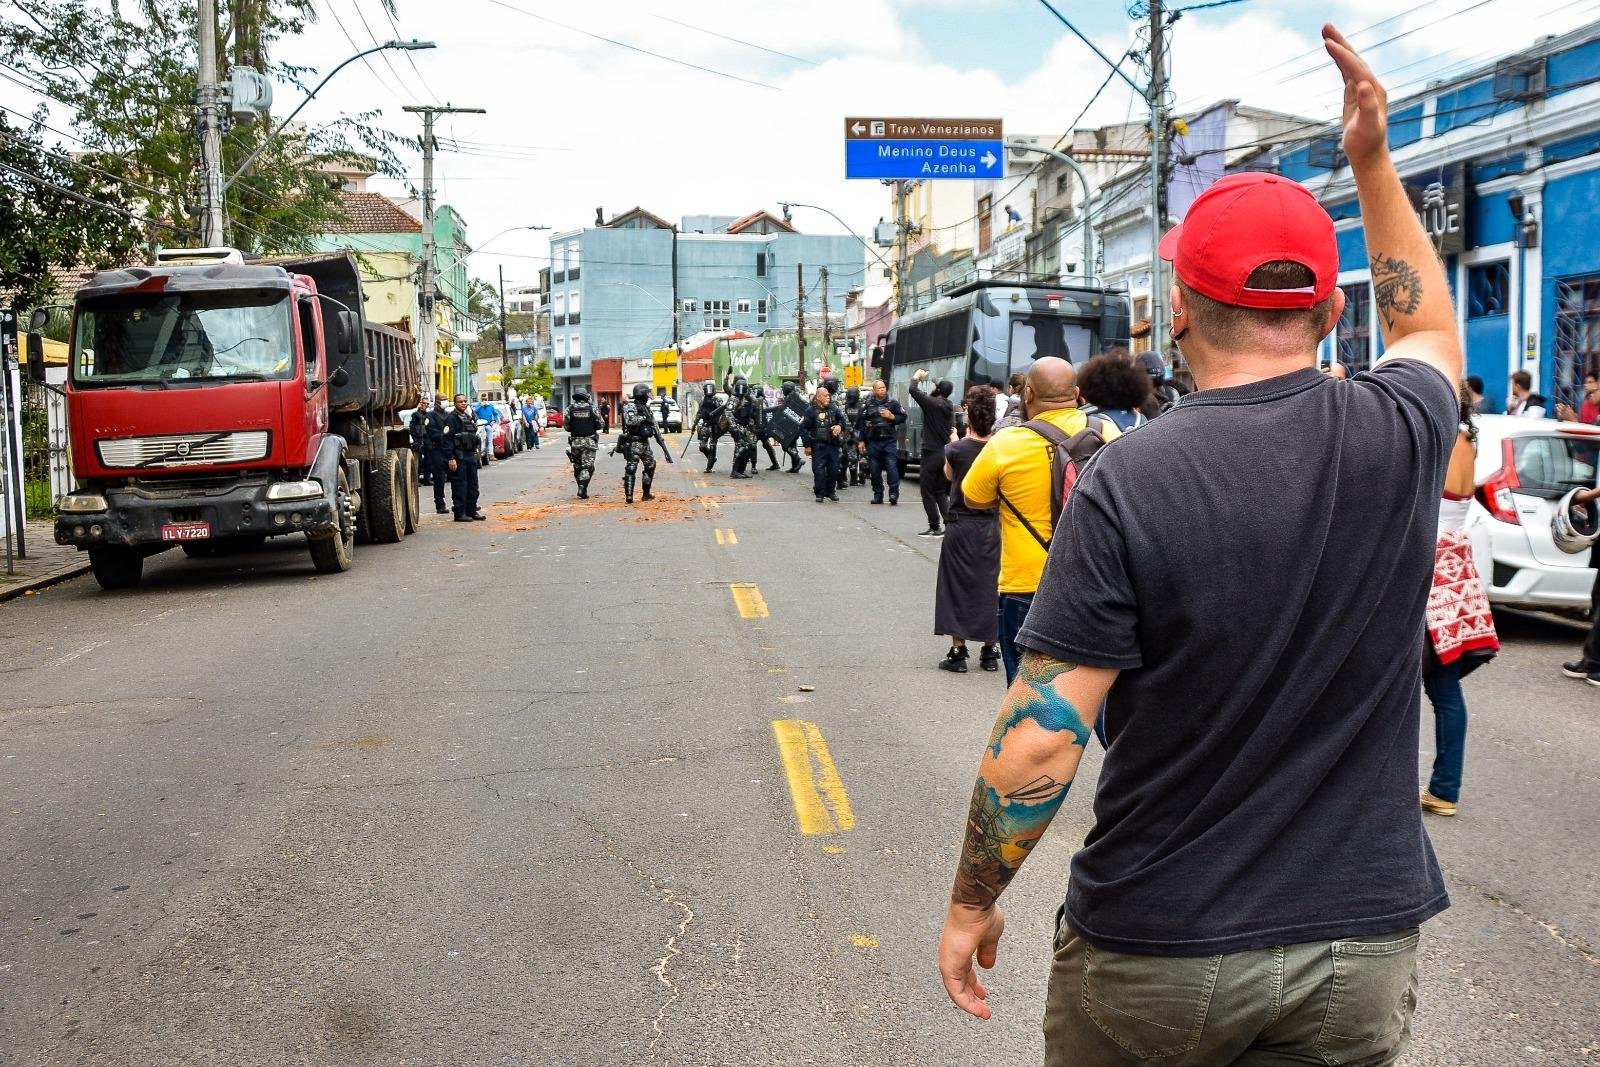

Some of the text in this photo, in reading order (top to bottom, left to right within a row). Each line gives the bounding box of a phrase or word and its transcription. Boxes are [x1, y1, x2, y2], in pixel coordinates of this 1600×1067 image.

[878, 145, 976, 157] Menino Deus
[922, 161, 976, 173] Azenha
